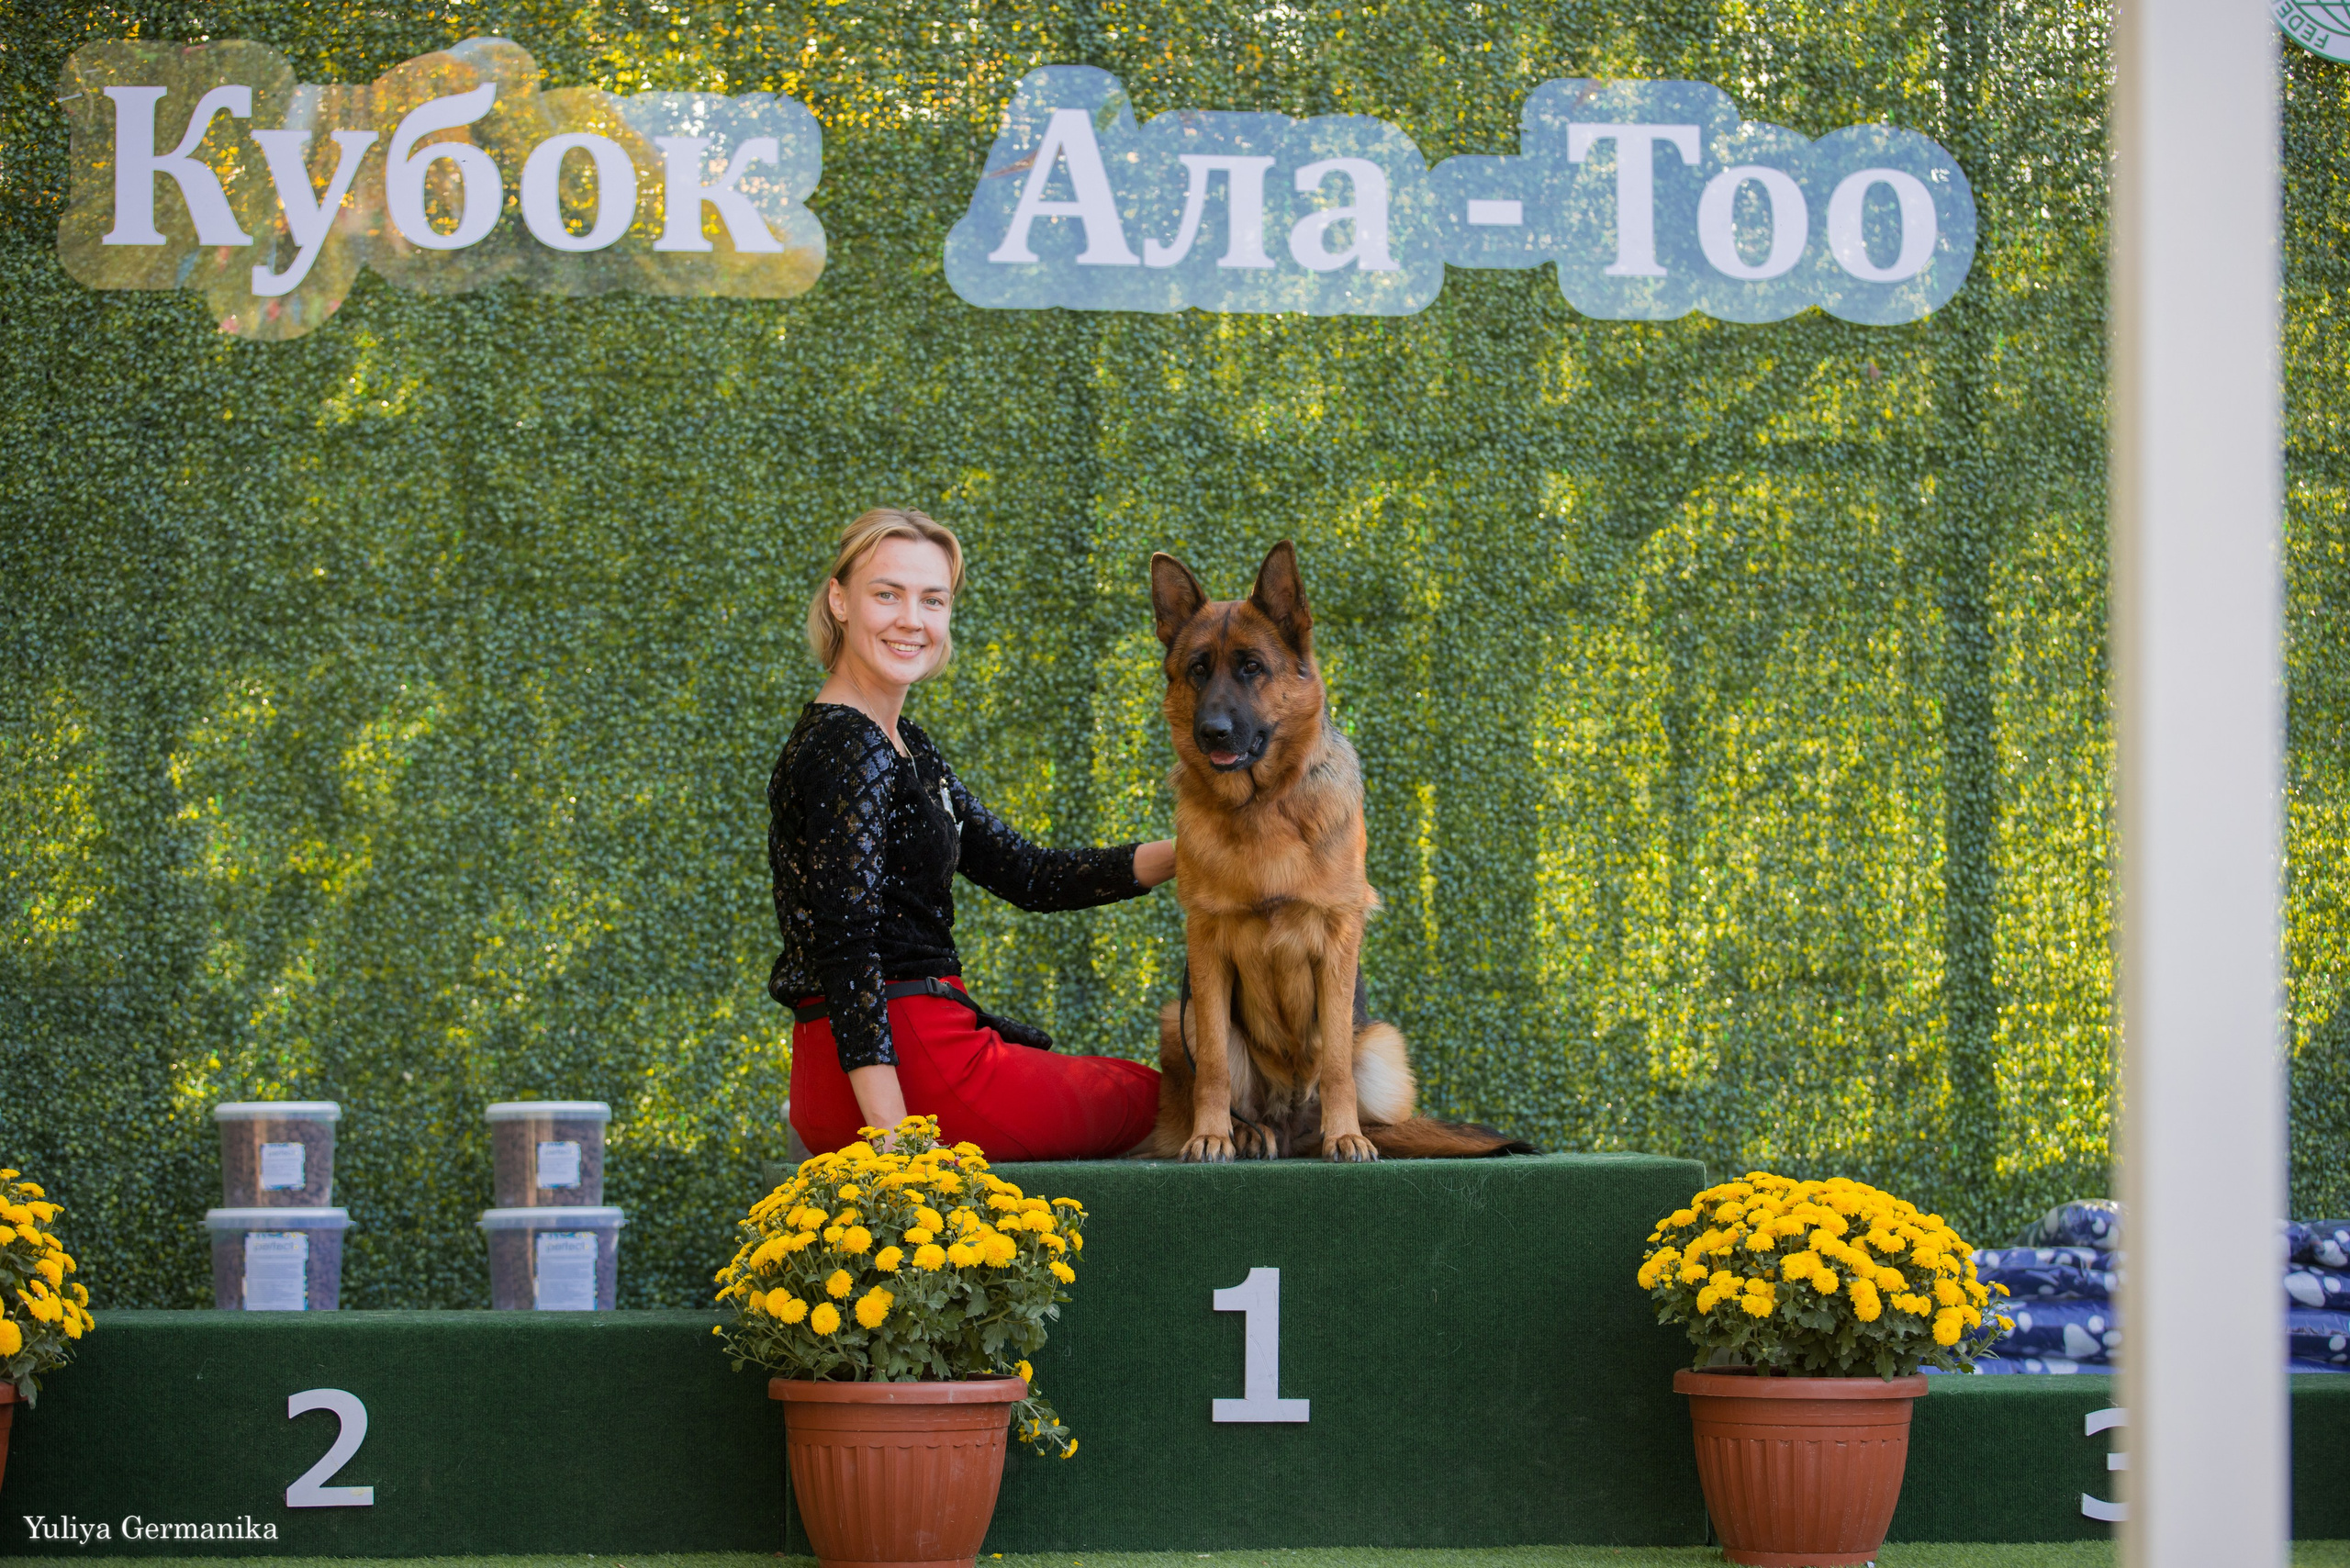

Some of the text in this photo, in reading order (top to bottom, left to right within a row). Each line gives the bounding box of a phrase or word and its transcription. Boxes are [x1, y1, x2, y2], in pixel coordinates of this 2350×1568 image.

[2272, 0, 2331, 50] FEDE
[102, 82, 785, 297] Кубок
[986, 107, 1401, 273] Ала
[1566, 121, 1939, 283] Тоо
[1212, 1267, 1310, 1422] 1
[285, 1388, 375, 1507] 2
